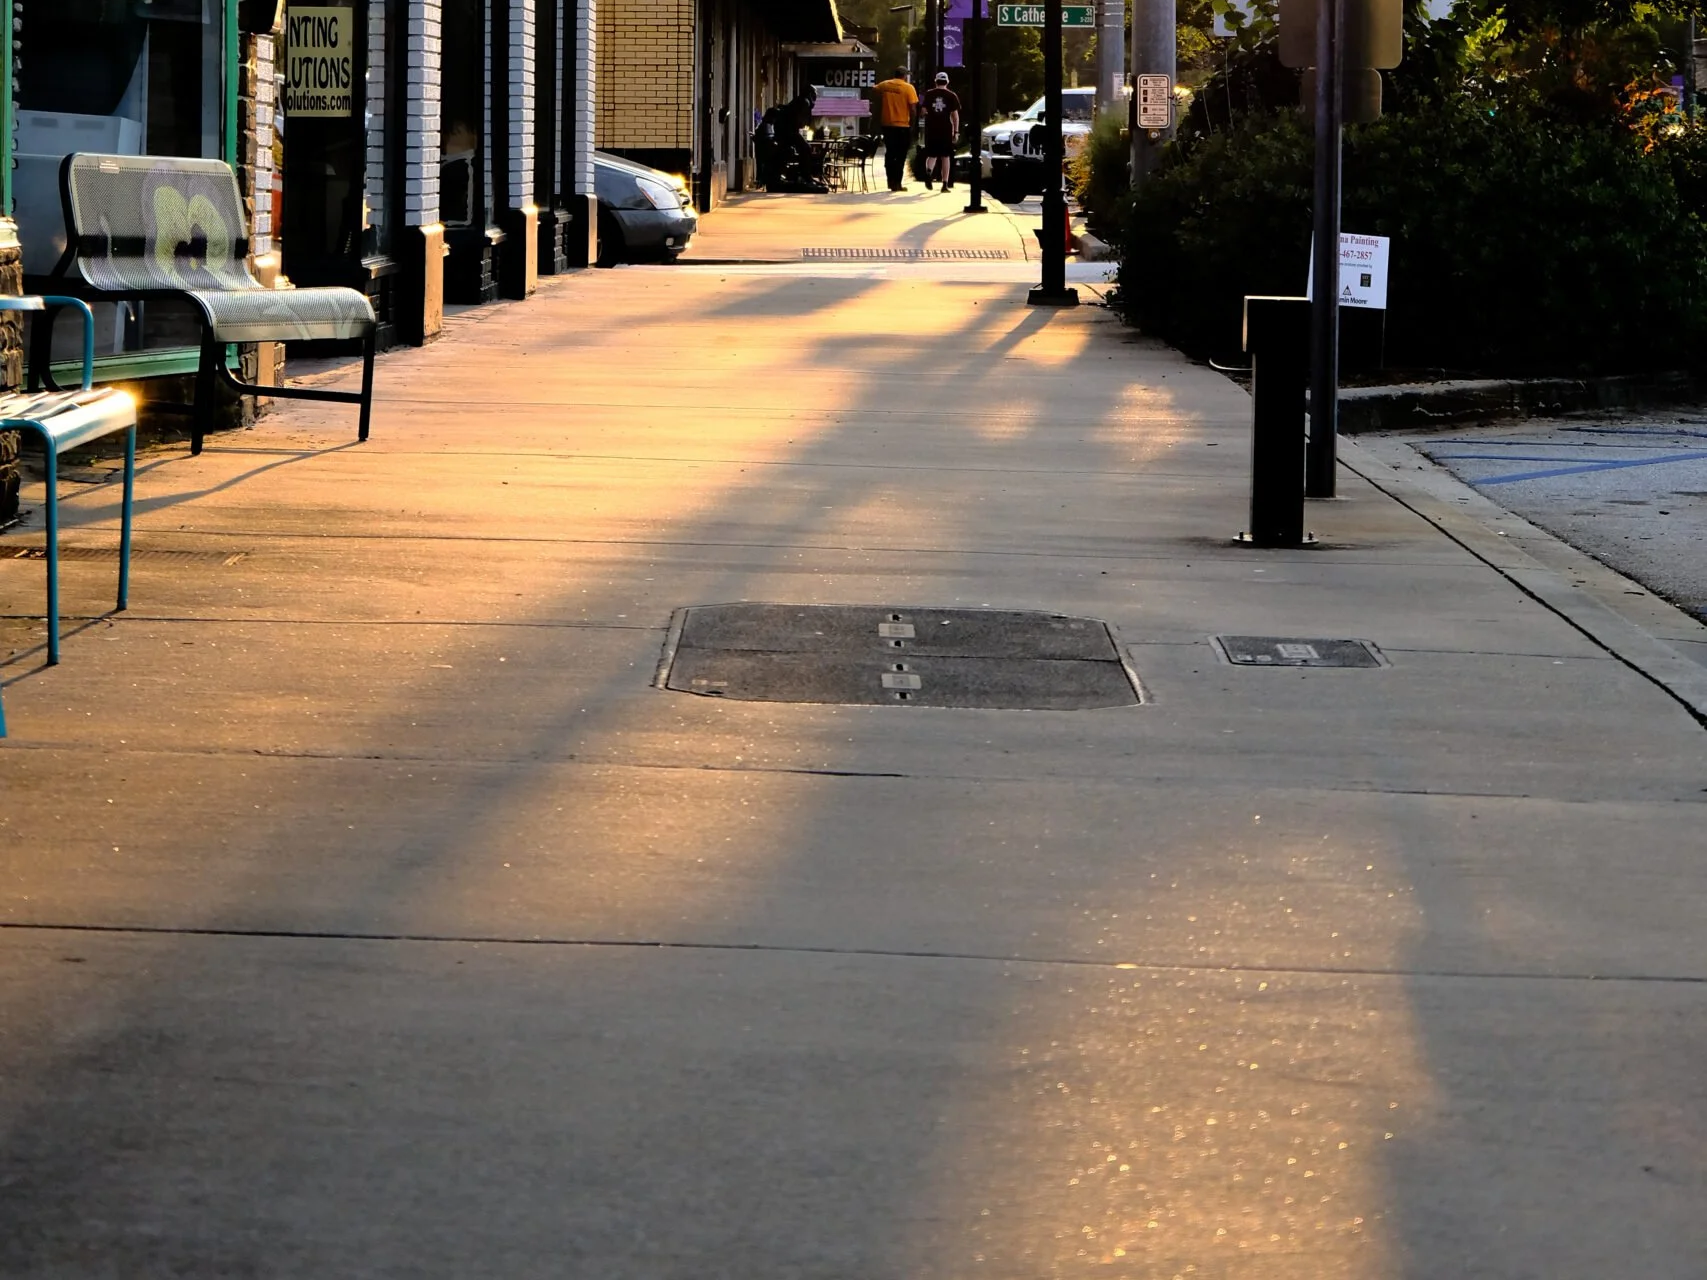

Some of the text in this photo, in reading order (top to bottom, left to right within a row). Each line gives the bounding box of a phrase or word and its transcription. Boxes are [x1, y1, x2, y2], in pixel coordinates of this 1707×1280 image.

[1001, 6, 1009, 22] S
[1014, 6, 1069, 23] Cathee
[286, 56, 351, 89] UTIONS
[825, 70, 876, 88] COFFEE
[1350, 235, 1379, 248] Painting
[1350, 297, 1368, 305] Moore
